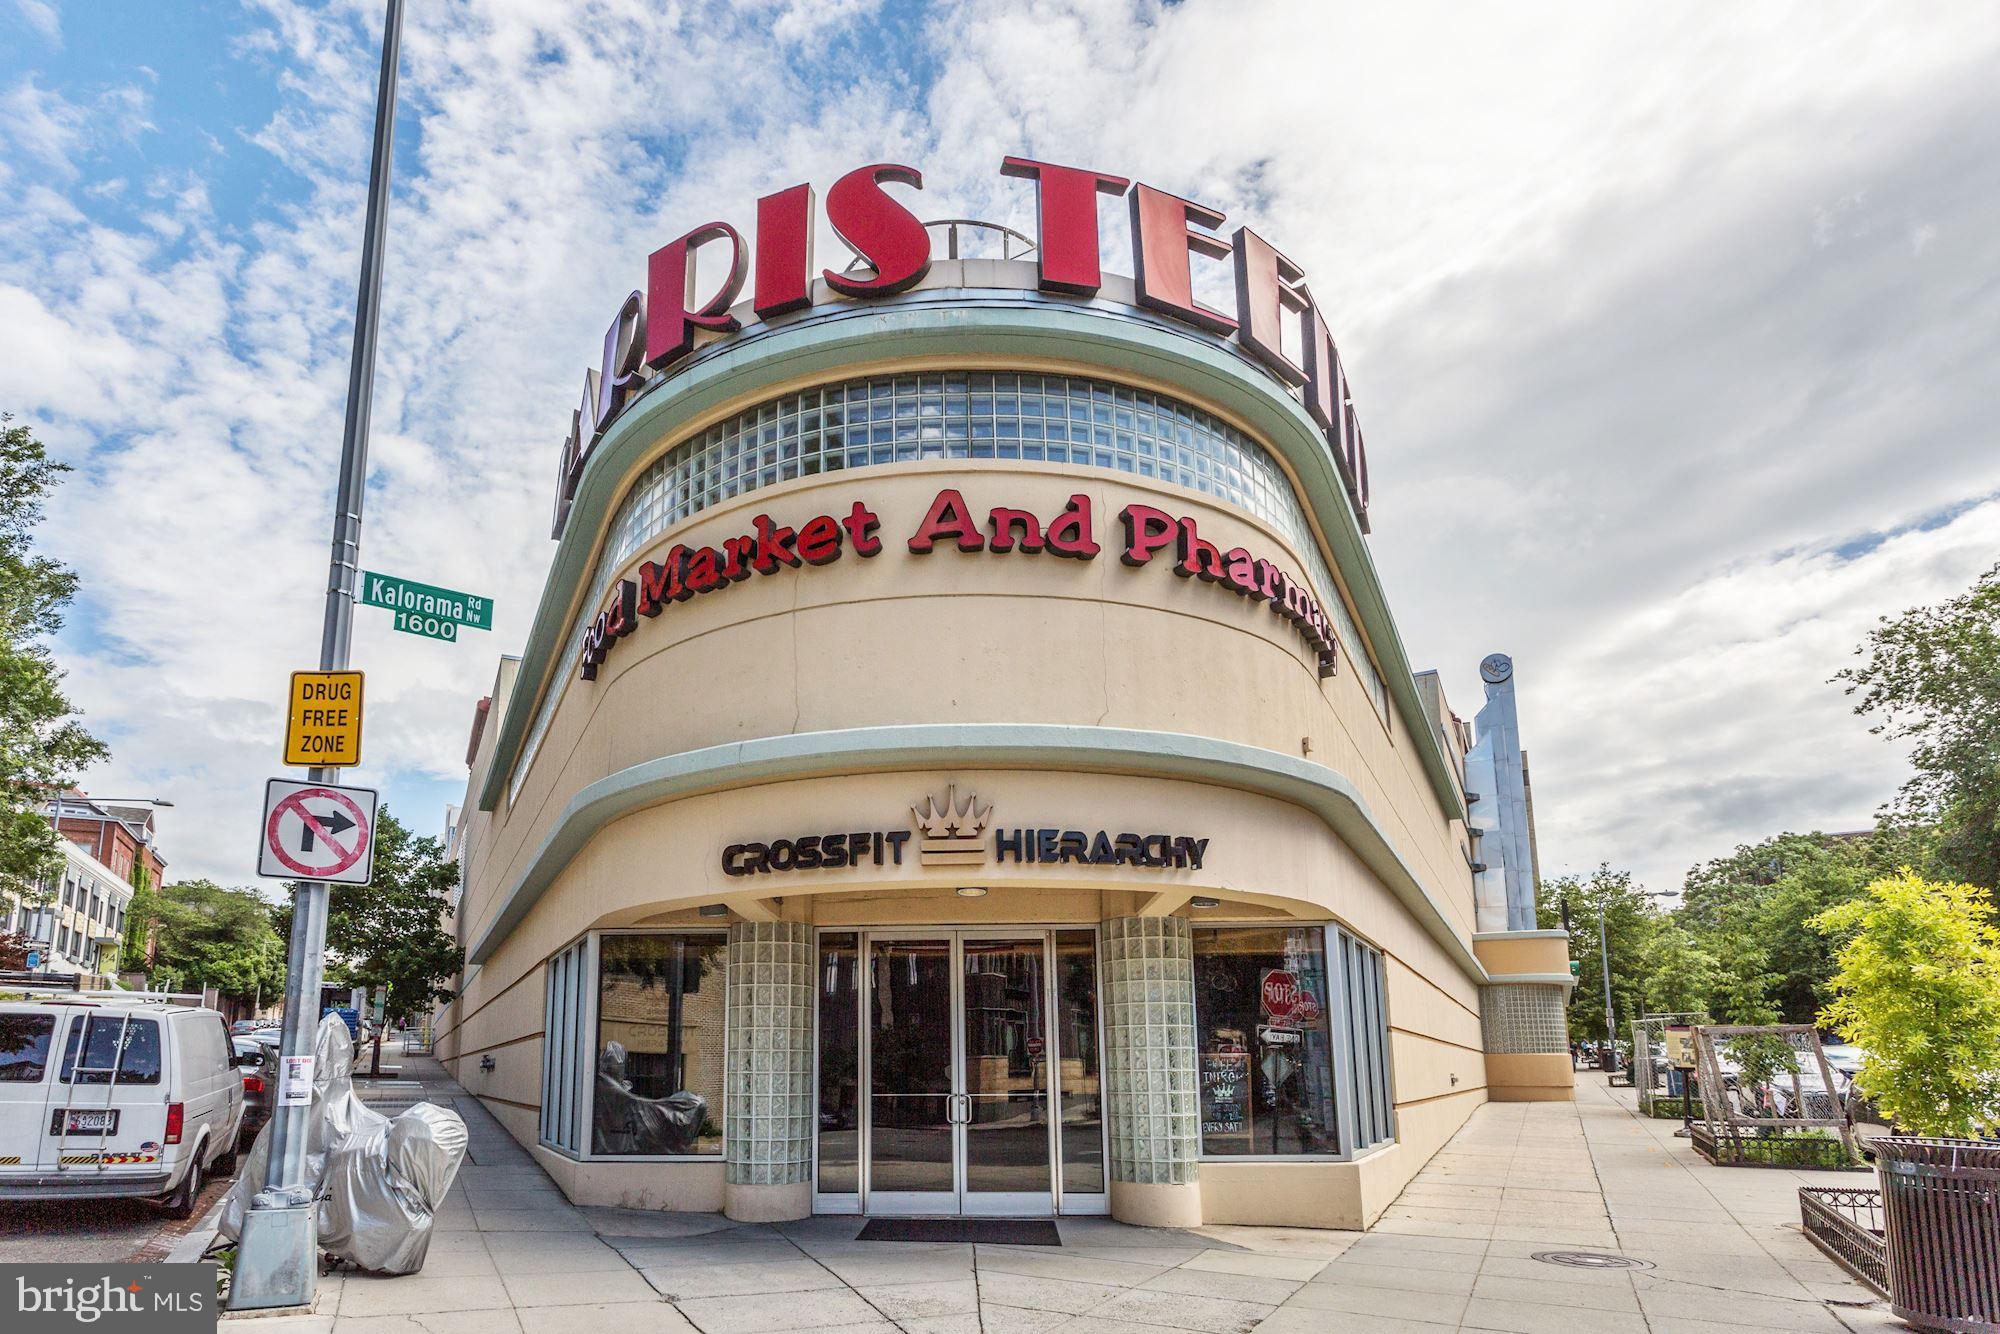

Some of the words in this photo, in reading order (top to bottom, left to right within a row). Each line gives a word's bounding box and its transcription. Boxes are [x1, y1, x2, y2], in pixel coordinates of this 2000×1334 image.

[637, 500, 883, 619] Market
[907, 488, 1101, 561] And
[371, 578, 463, 620] Kalorama
[467, 596, 482, 611] Rd
[397, 612, 456, 639] 1600
[302, 682, 351, 701] DRUG
[302, 709, 348, 727] FREE
[301, 735, 345, 753] ZONE
[722, 830, 911, 876] CROSSFIT
[995, 828, 1210, 870] HIERARCHY
